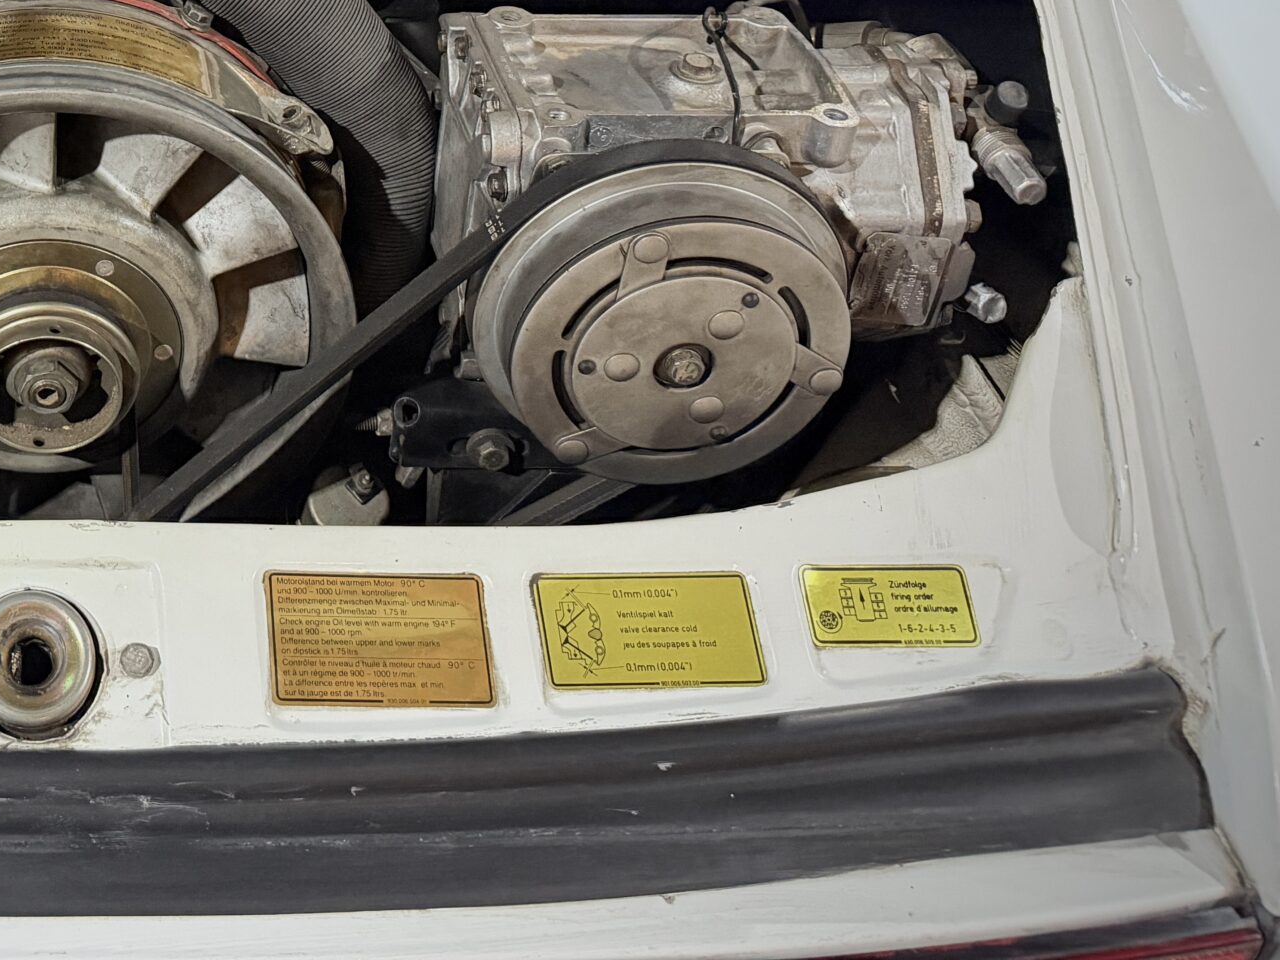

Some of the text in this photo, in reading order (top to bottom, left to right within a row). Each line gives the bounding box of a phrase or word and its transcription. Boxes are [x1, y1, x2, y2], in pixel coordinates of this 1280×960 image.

[326, 578, 338, 586] bei
[888, 580, 927, 590] Zündfolge
[278, 596, 336, 606] Differenzmenge
[891, 593, 911, 602] firing
[279, 607, 320, 615] markierung
[916, 604, 958, 614] d'allumage
[617, 610, 656, 619] Ventilspiel
[280, 617, 302, 625] Check
[332, 618, 344, 626] Oil
[404, 621, 429, 629] engine
[898, 624, 956, 633] 1-6-2-4-3-5
[280, 637, 320, 645] Difference
[623, 641, 635, 650] jeu
[652, 641, 690, 650] soupapes
[282, 658, 317, 667] Contrôler
[355, 660, 380, 668] d'huile
[448, 661, 464, 669] 90°
[468, 661, 475, 669] C
[310, 670, 336, 678] régime
[373, 670, 390, 678] 1000
